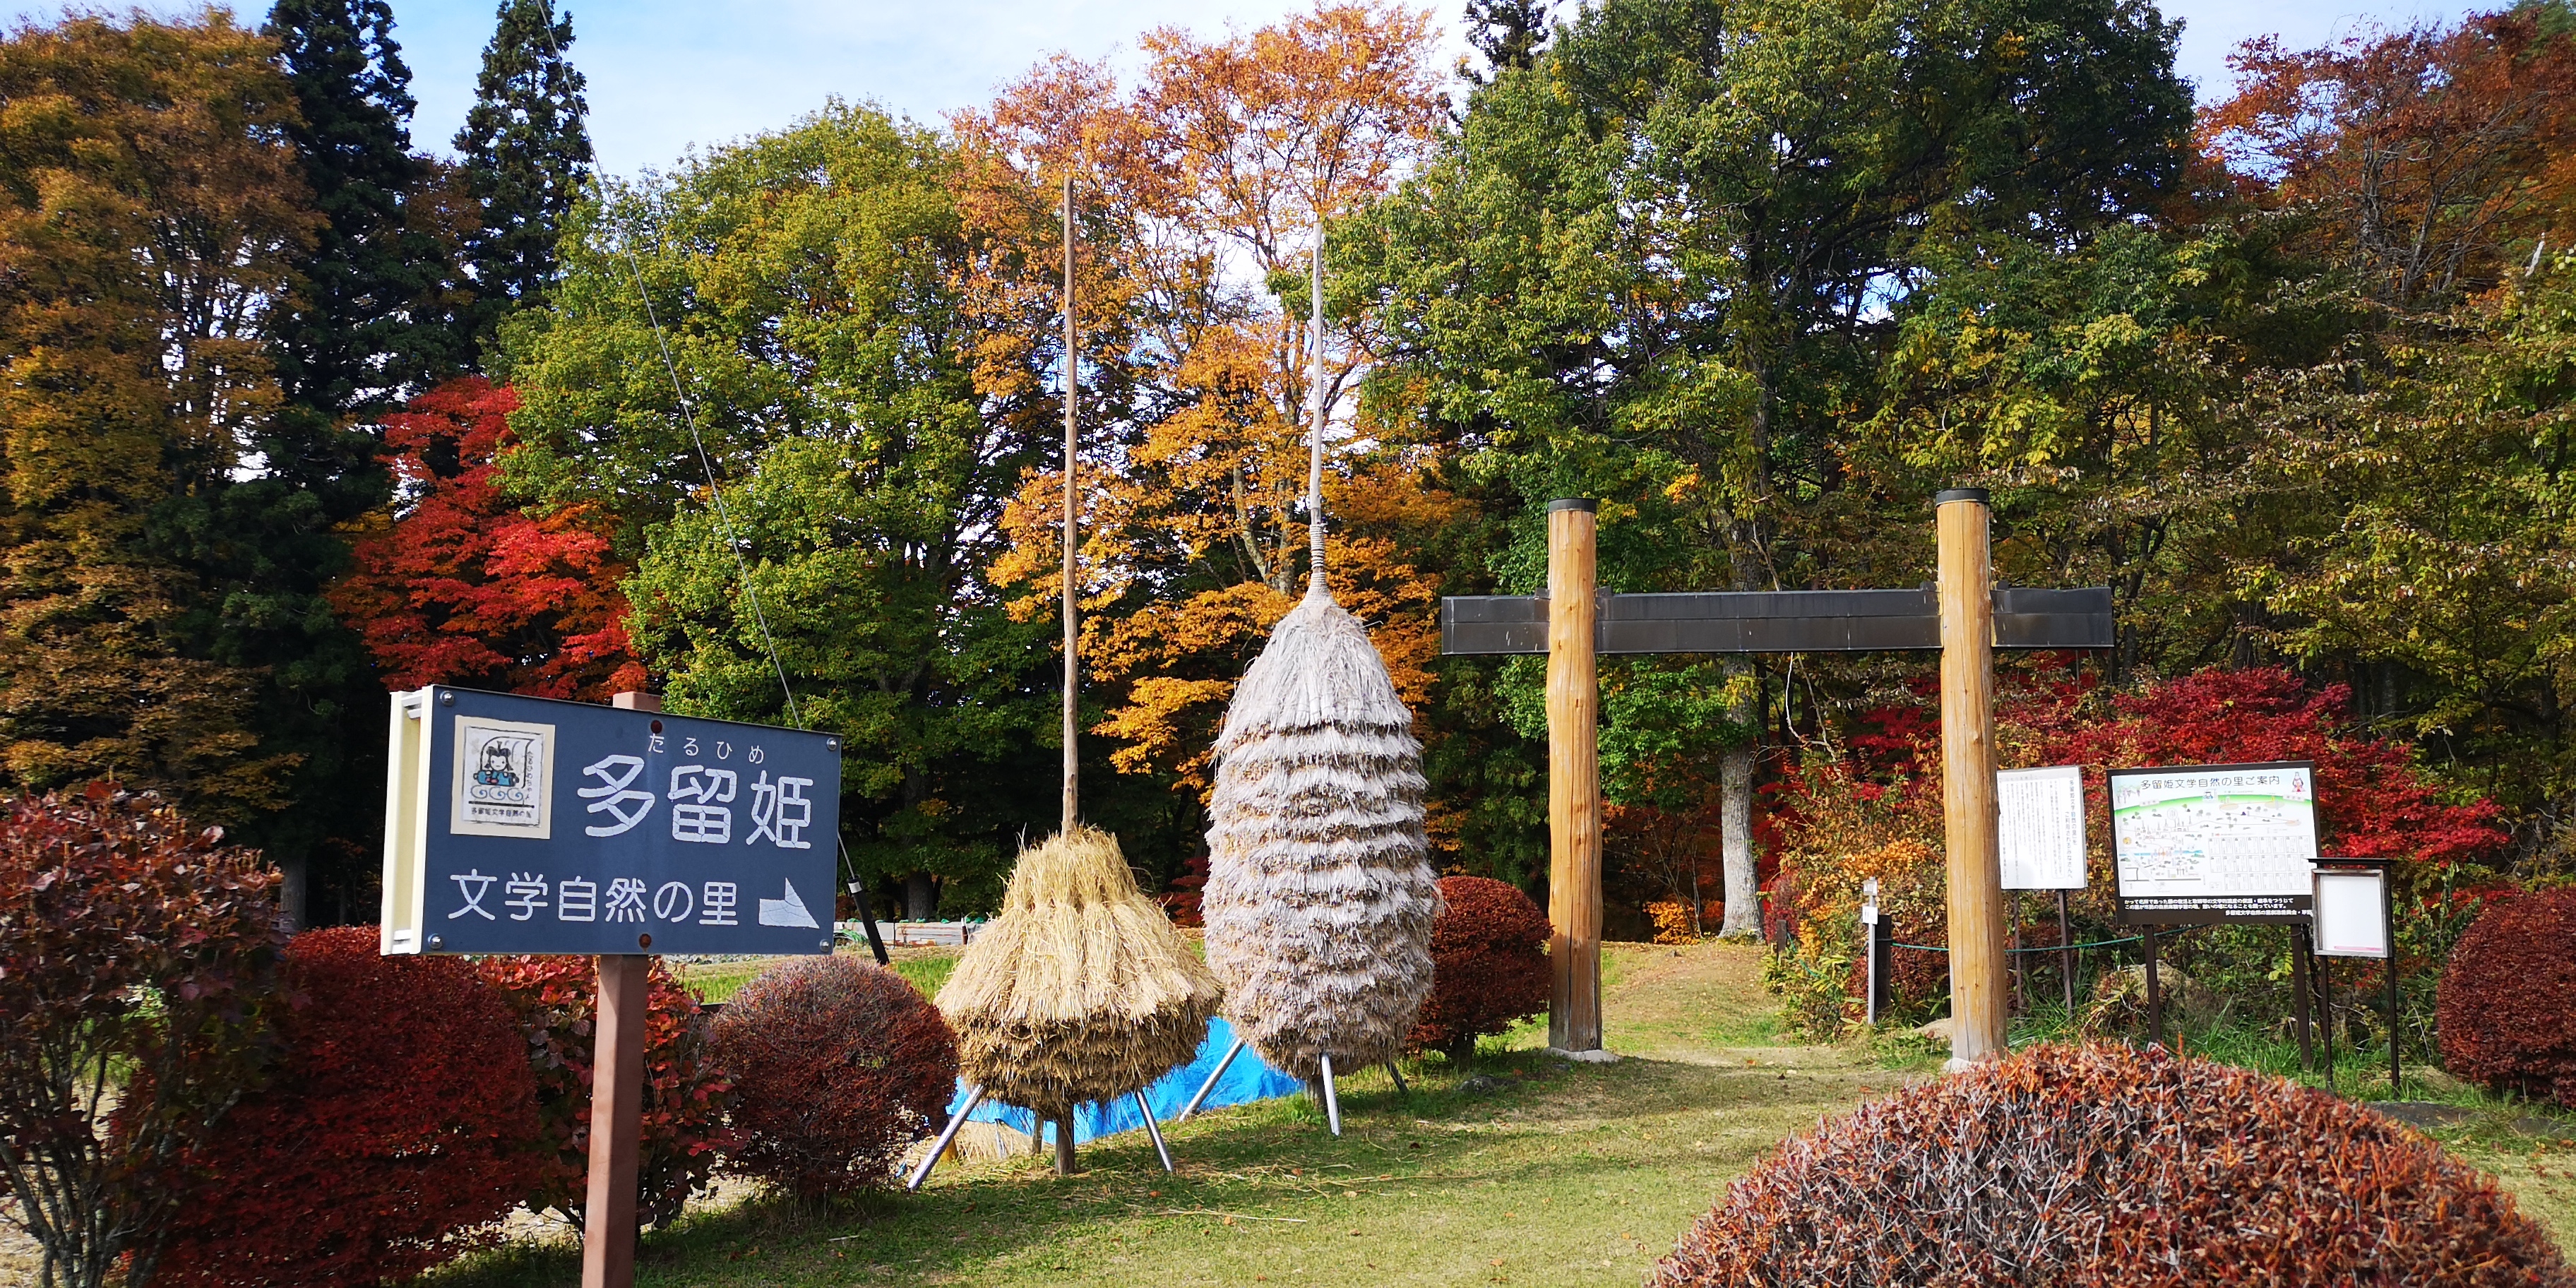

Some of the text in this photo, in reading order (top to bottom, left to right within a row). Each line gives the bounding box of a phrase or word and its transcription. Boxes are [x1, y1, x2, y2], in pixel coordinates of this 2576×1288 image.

[648, 733, 765, 764] たるひめ
[578, 754, 813, 849] 多留姫
[2140, 775, 2280, 790] 多留姫文学自然の里ご案内
[448, 869, 739, 926] 文学自然の里
